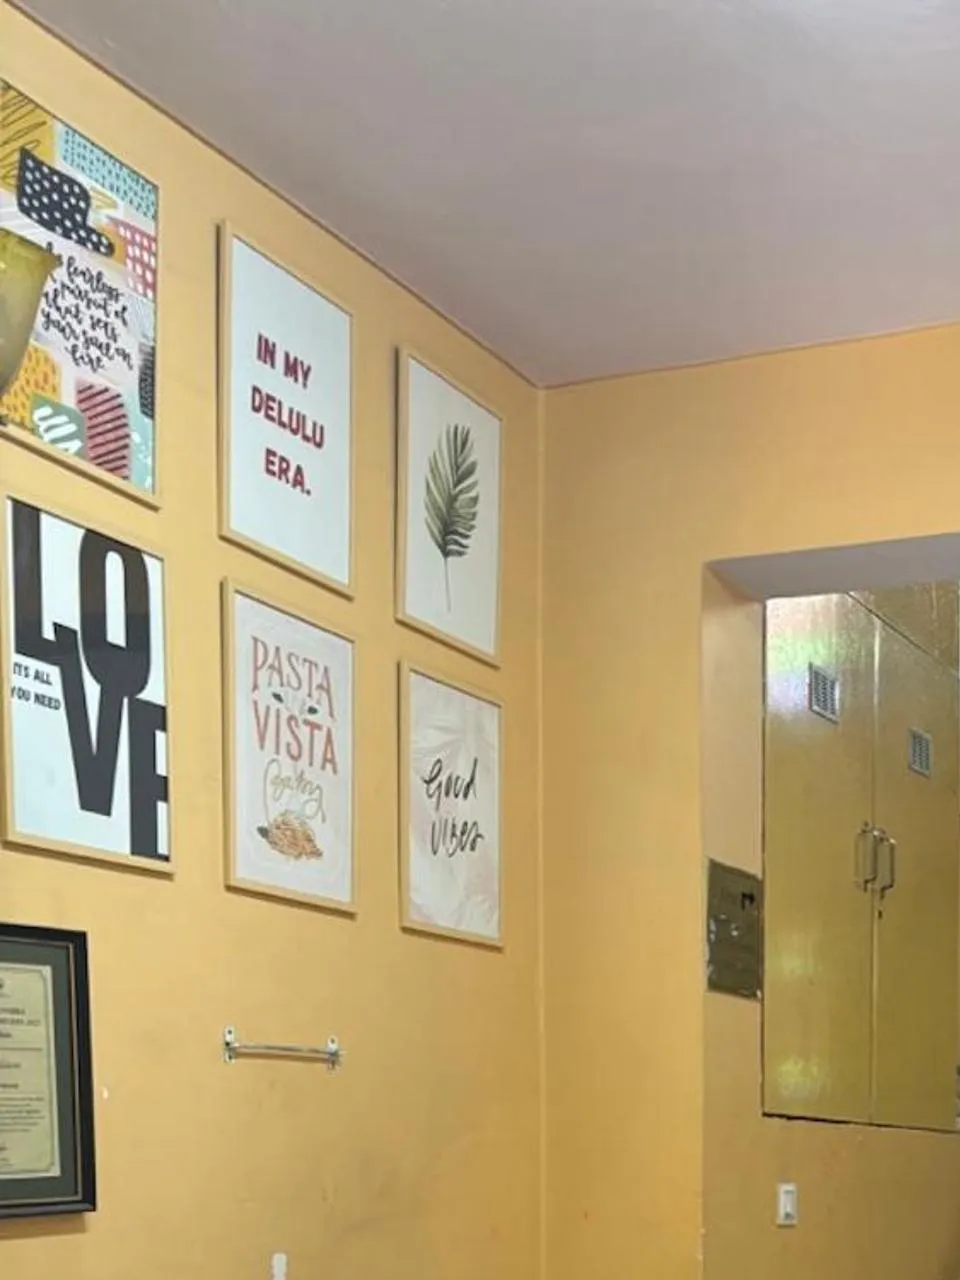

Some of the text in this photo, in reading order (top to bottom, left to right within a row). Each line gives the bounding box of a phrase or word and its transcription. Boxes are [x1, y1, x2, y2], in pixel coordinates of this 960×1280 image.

[257, 333, 312, 390] IN MY
[251, 385, 325, 449] DELULU
[264, 447, 312, 496] ERA.
[34, 668, 53, 686] ALL
[34, 692, 61, 711] NEED
[251, 635, 335, 720] PASTA
[253, 700, 338, 775] VISTA
